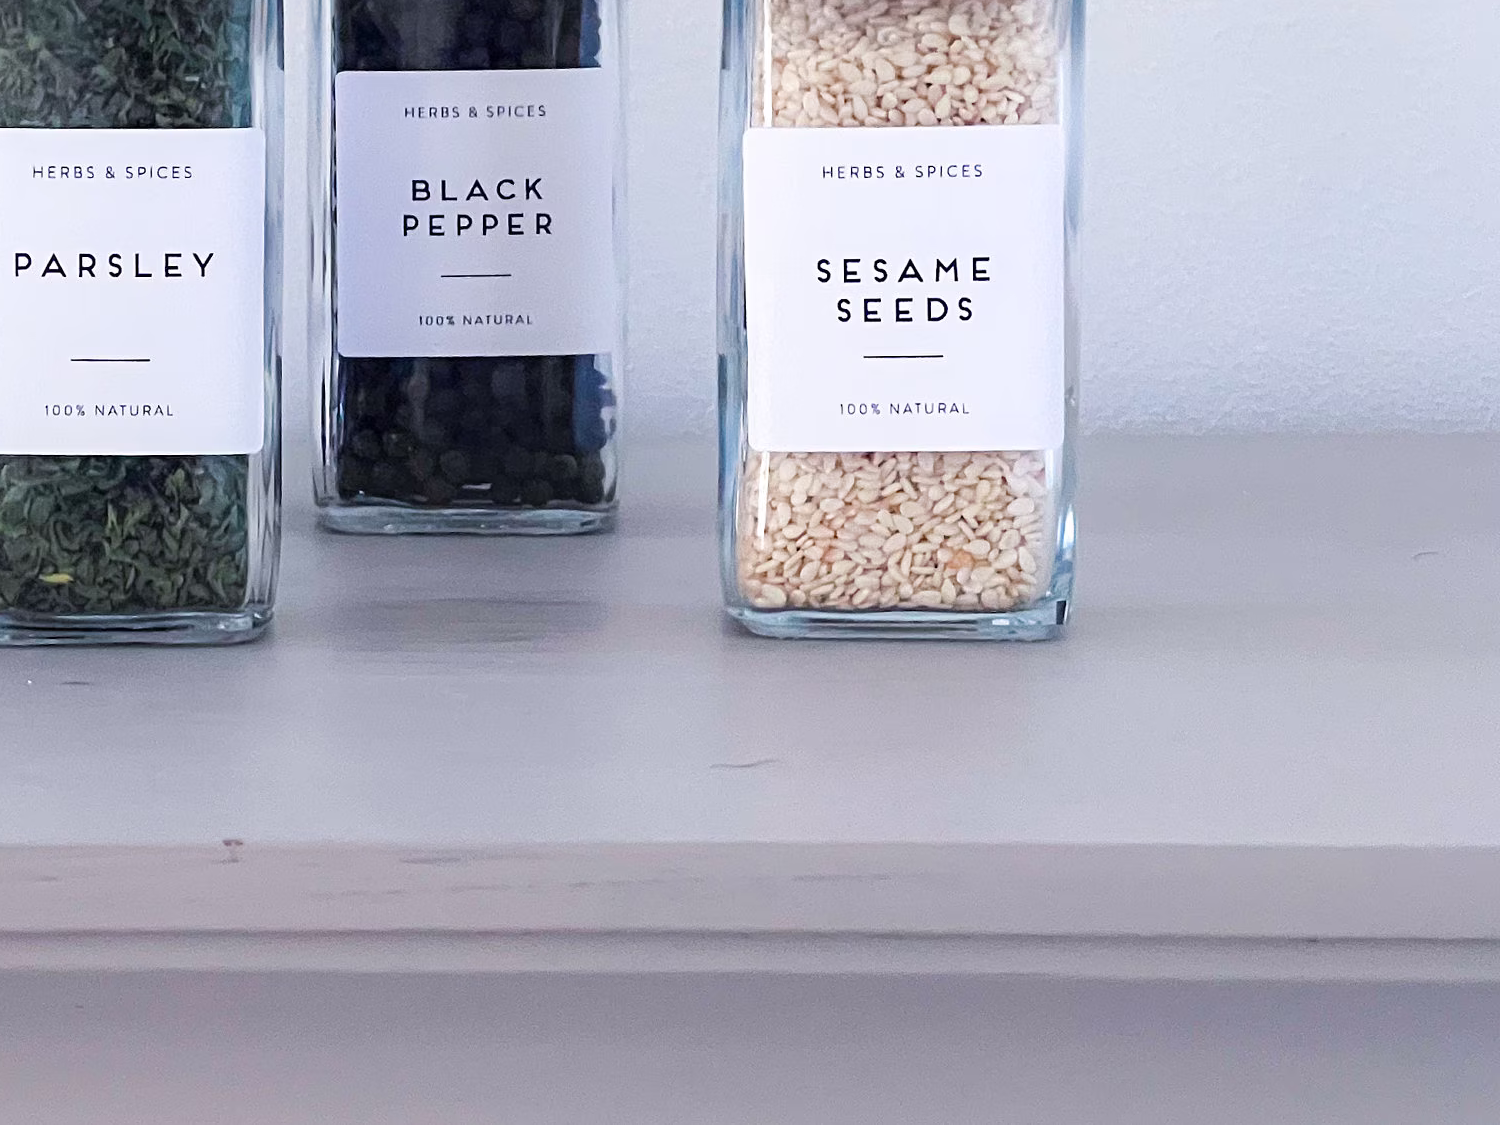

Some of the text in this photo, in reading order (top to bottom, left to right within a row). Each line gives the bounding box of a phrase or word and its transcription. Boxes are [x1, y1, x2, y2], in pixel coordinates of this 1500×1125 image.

[404, 104, 547, 120] HERBS & SPICES
[32, 165, 193, 180] HERBS & SPICES
[822, 163, 983, 180] HERBS & SPICES
[411, 176, 544, 202] BLACK
[402, 212, 553, 238] PEPPER
[14, 252, 215, 279] PARSLEY
[816, 256, 991, 284] SESAME
[836, 296, 973, 324] SEEDS
[418, 313, 534, 327] 100% NATURAL
[44, 403, 174, 417] 100% NATURAL
[839, 402, 970, 416] 100% NATURAL
